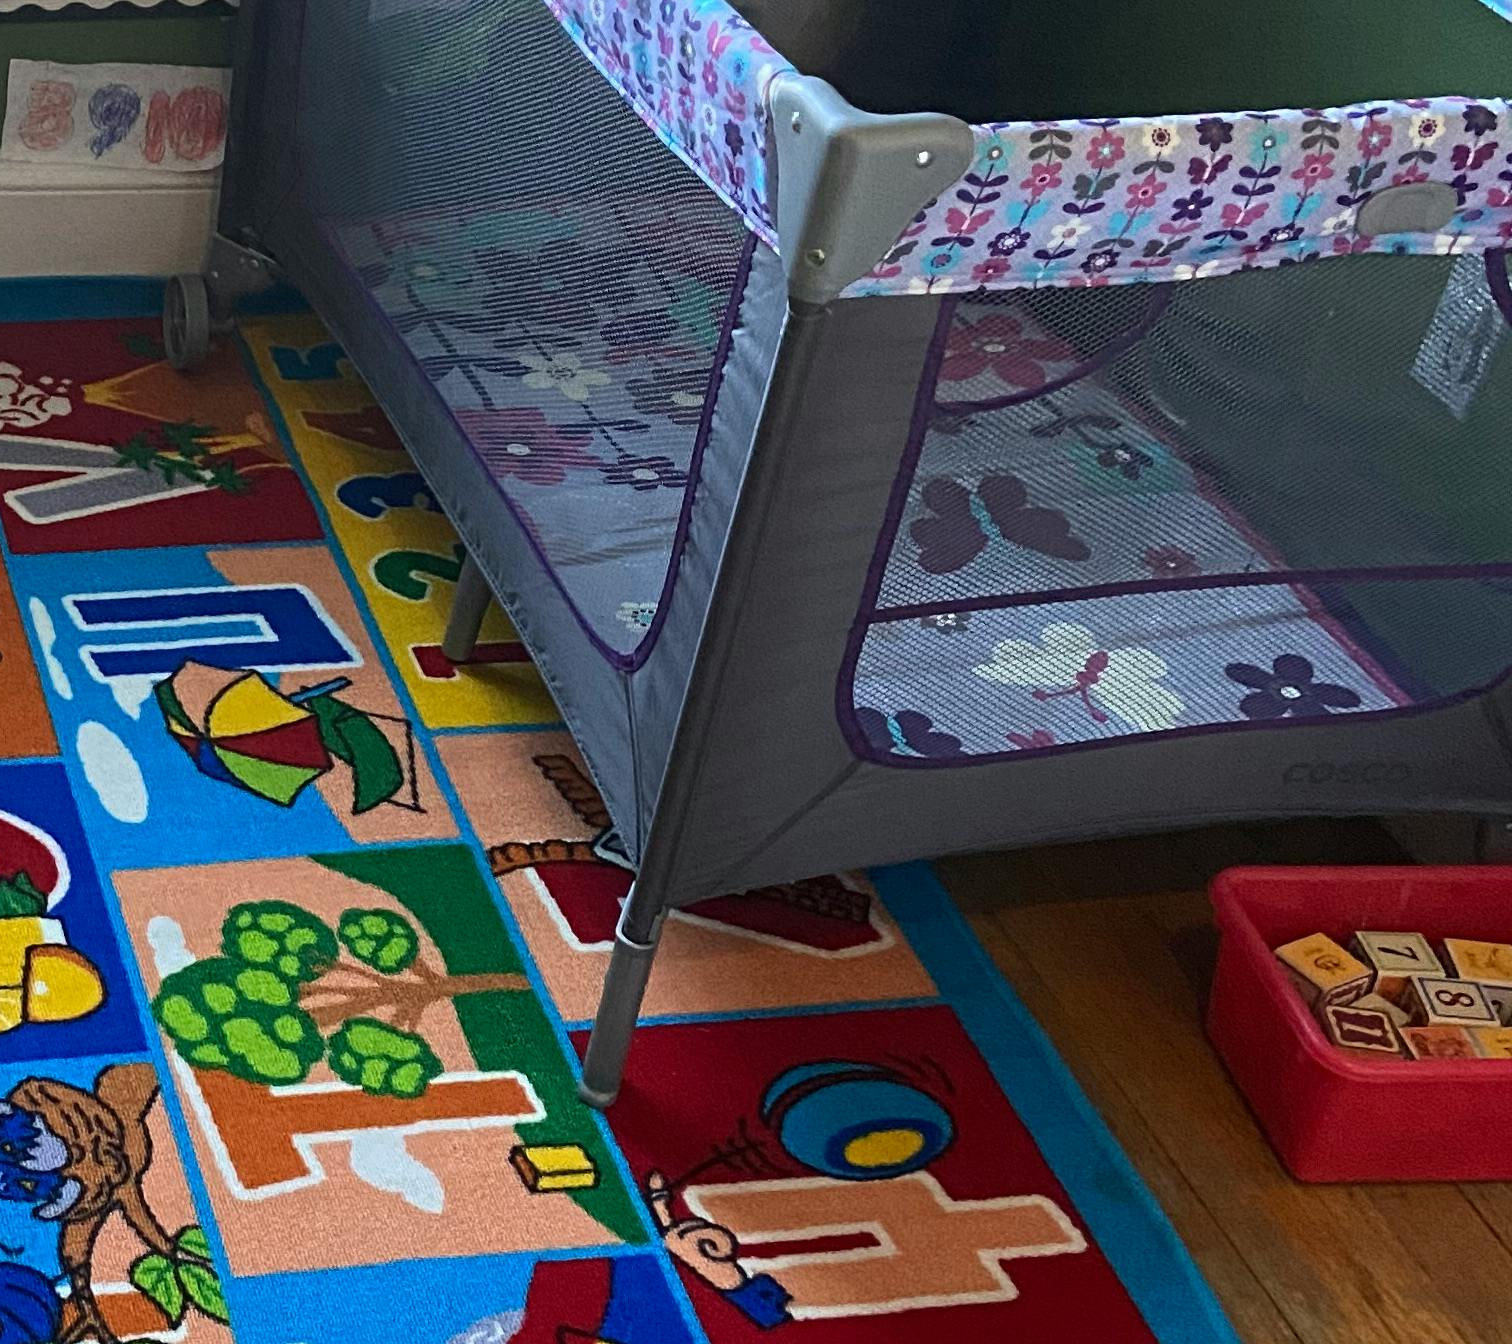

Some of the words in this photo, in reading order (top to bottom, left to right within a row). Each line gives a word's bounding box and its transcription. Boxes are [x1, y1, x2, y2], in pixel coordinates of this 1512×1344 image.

[61, 582, 364, 679] U
[1434, 989, 1475, 1008] 8
[174, 1051, 548, 1199] T
